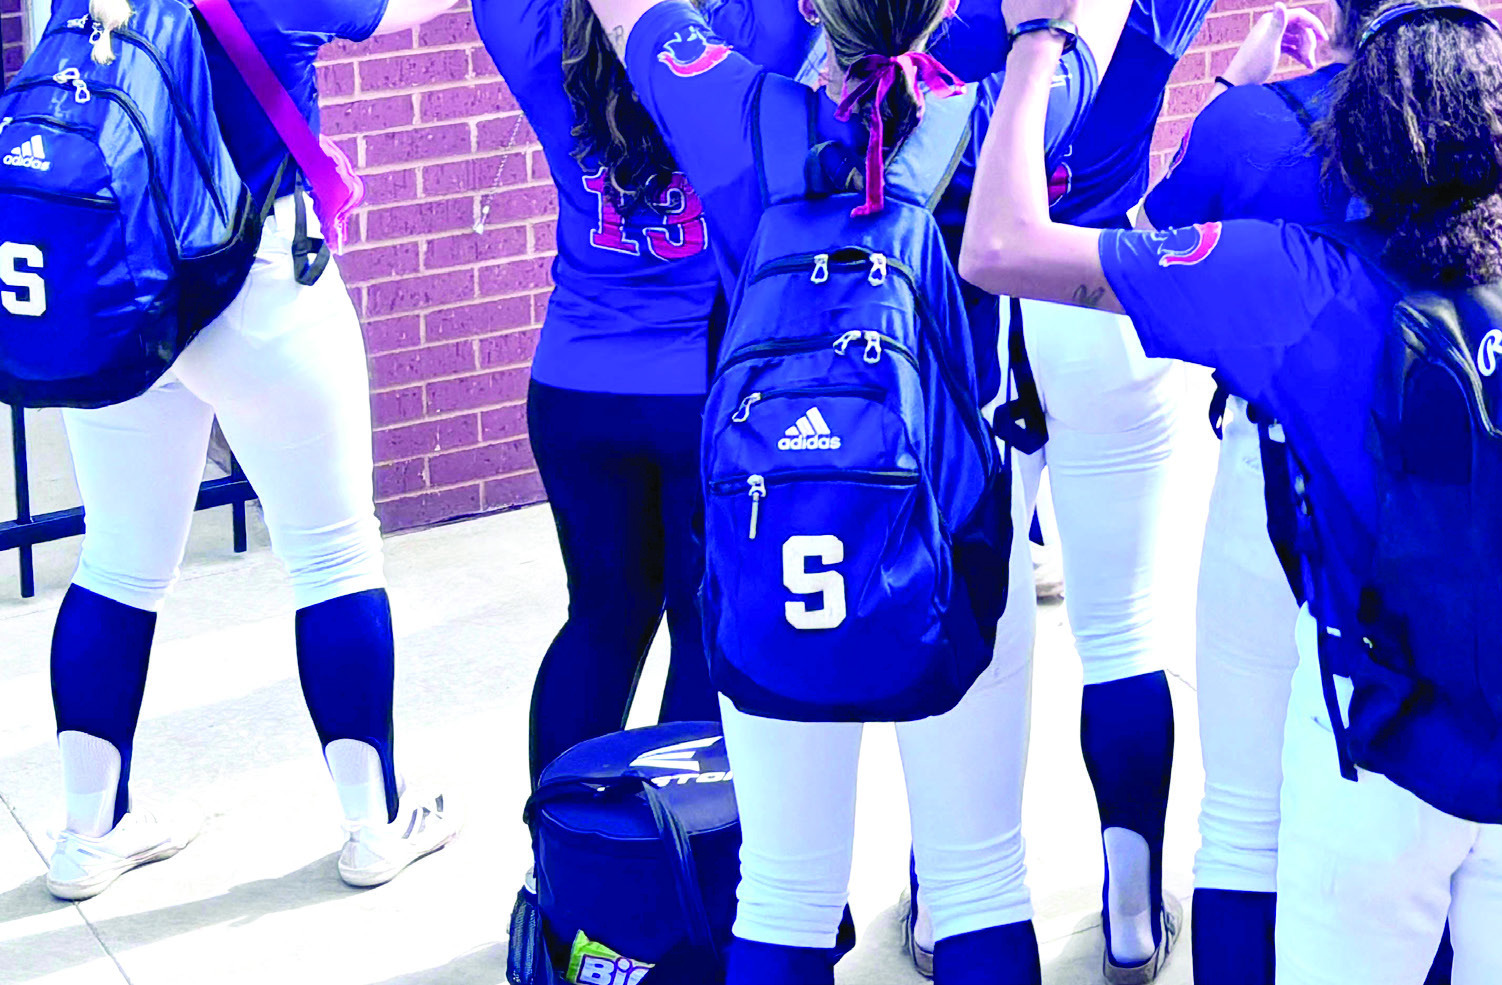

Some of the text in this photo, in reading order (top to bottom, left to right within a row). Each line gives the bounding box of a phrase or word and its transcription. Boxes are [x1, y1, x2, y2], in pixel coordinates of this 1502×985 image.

[3, 154, 50, 171] adidas
[582, 166, 708, 262] 13
[0, 241, 46, 316] S
[778, 435, 841, 450] adidas
[783, 535, 846, 629] S
